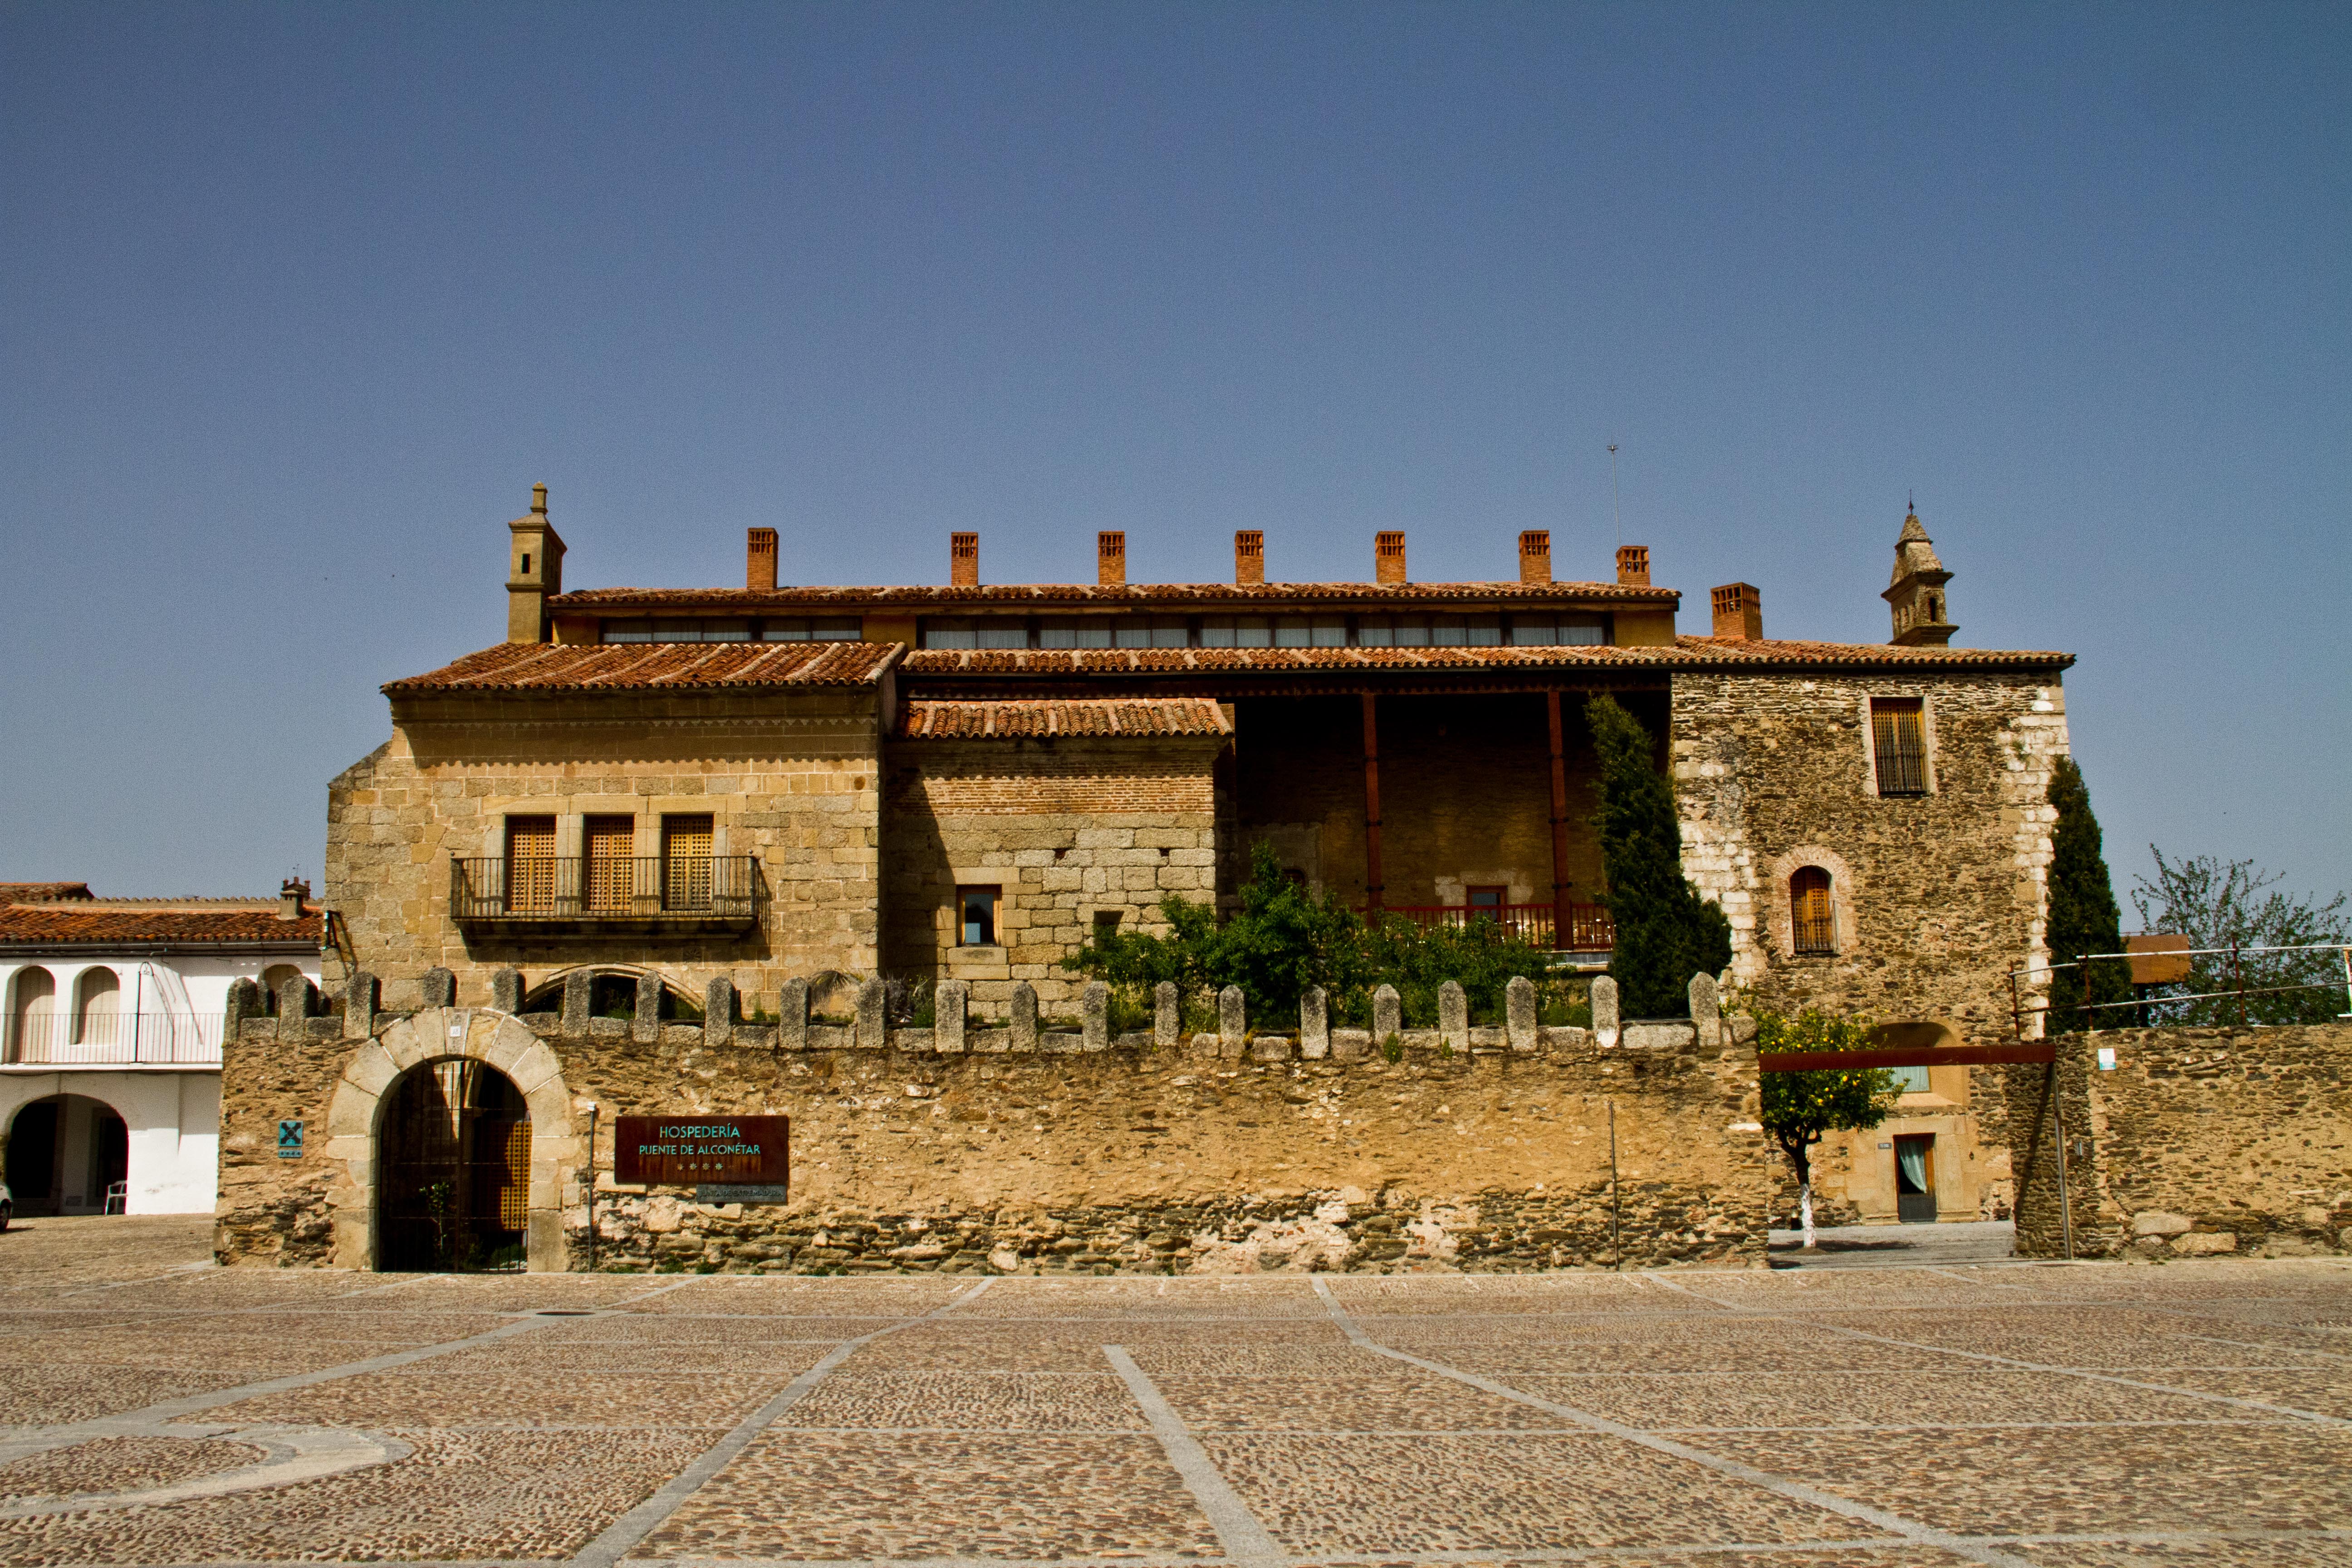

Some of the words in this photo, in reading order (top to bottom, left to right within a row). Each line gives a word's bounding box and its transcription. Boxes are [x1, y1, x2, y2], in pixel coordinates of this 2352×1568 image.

[660, 1123, 740, 1138] HOSPEDERÍA
[639, 1145, 677, 1155] PUENTE
[681, 1145, 694, 1155] DE
[697, 1142, 761, 1155] ALCONÉTAR
